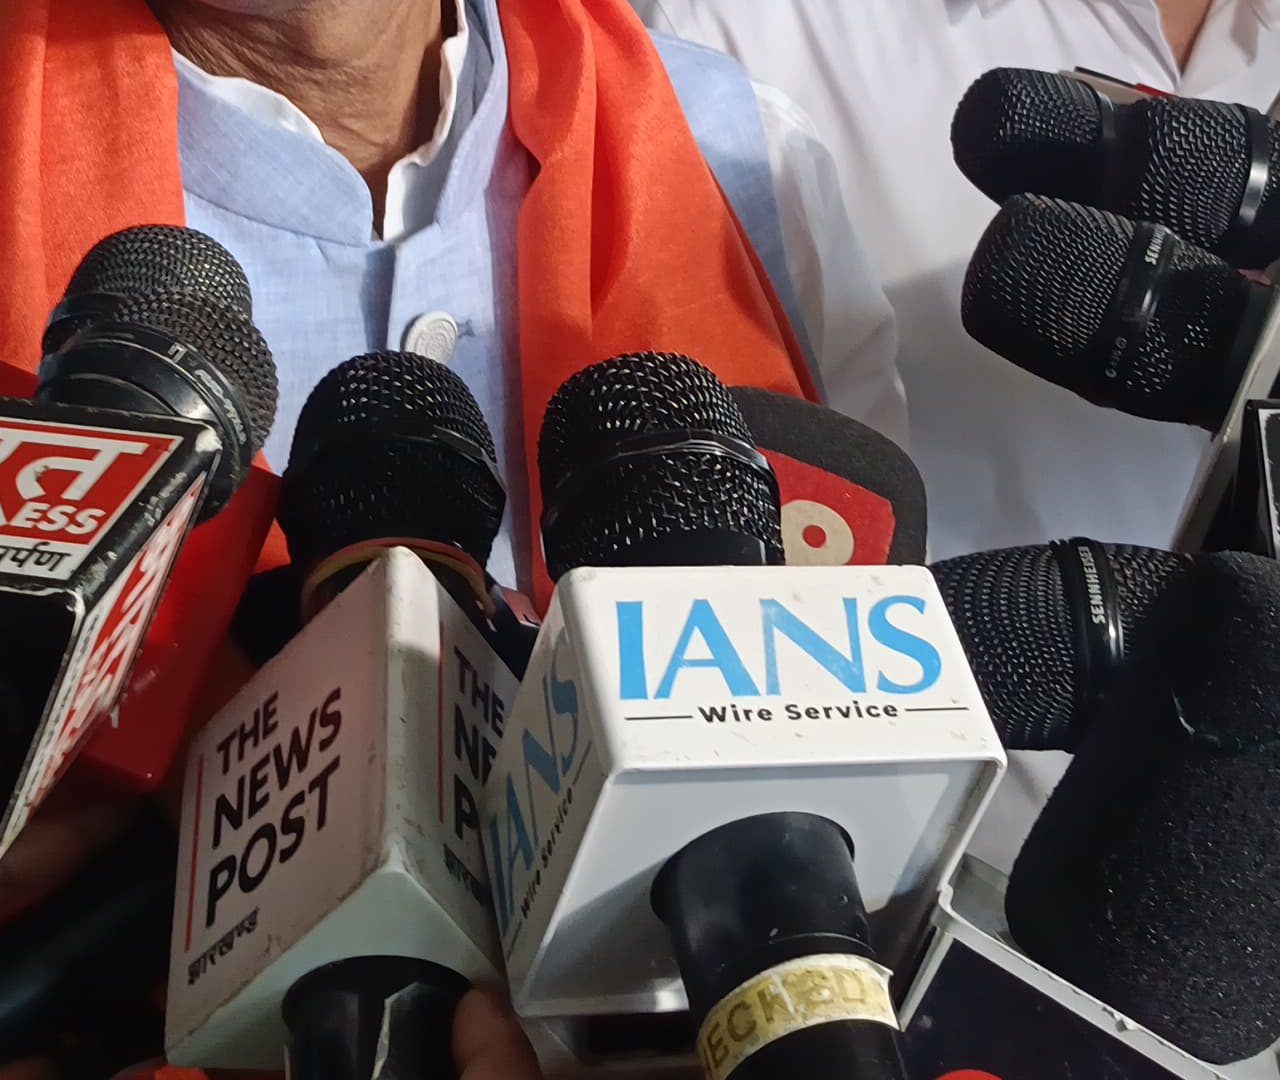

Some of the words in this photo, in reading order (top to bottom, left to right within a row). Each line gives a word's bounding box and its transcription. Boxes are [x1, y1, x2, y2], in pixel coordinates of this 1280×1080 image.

[1077, 545, 1107, 625] SENNHEISER
[454, 644, 505, 739] THE
[615, 594, 943, 700] IANS
[216, 690, 280, 776] THE
[697, 703, 774, 724] Wire
[785, 700, 900, 722] Service
[211, 686, 343, 850] NEWS
[489, 626, 579, 938] IANS
[205, 754, 341, 930] POST
